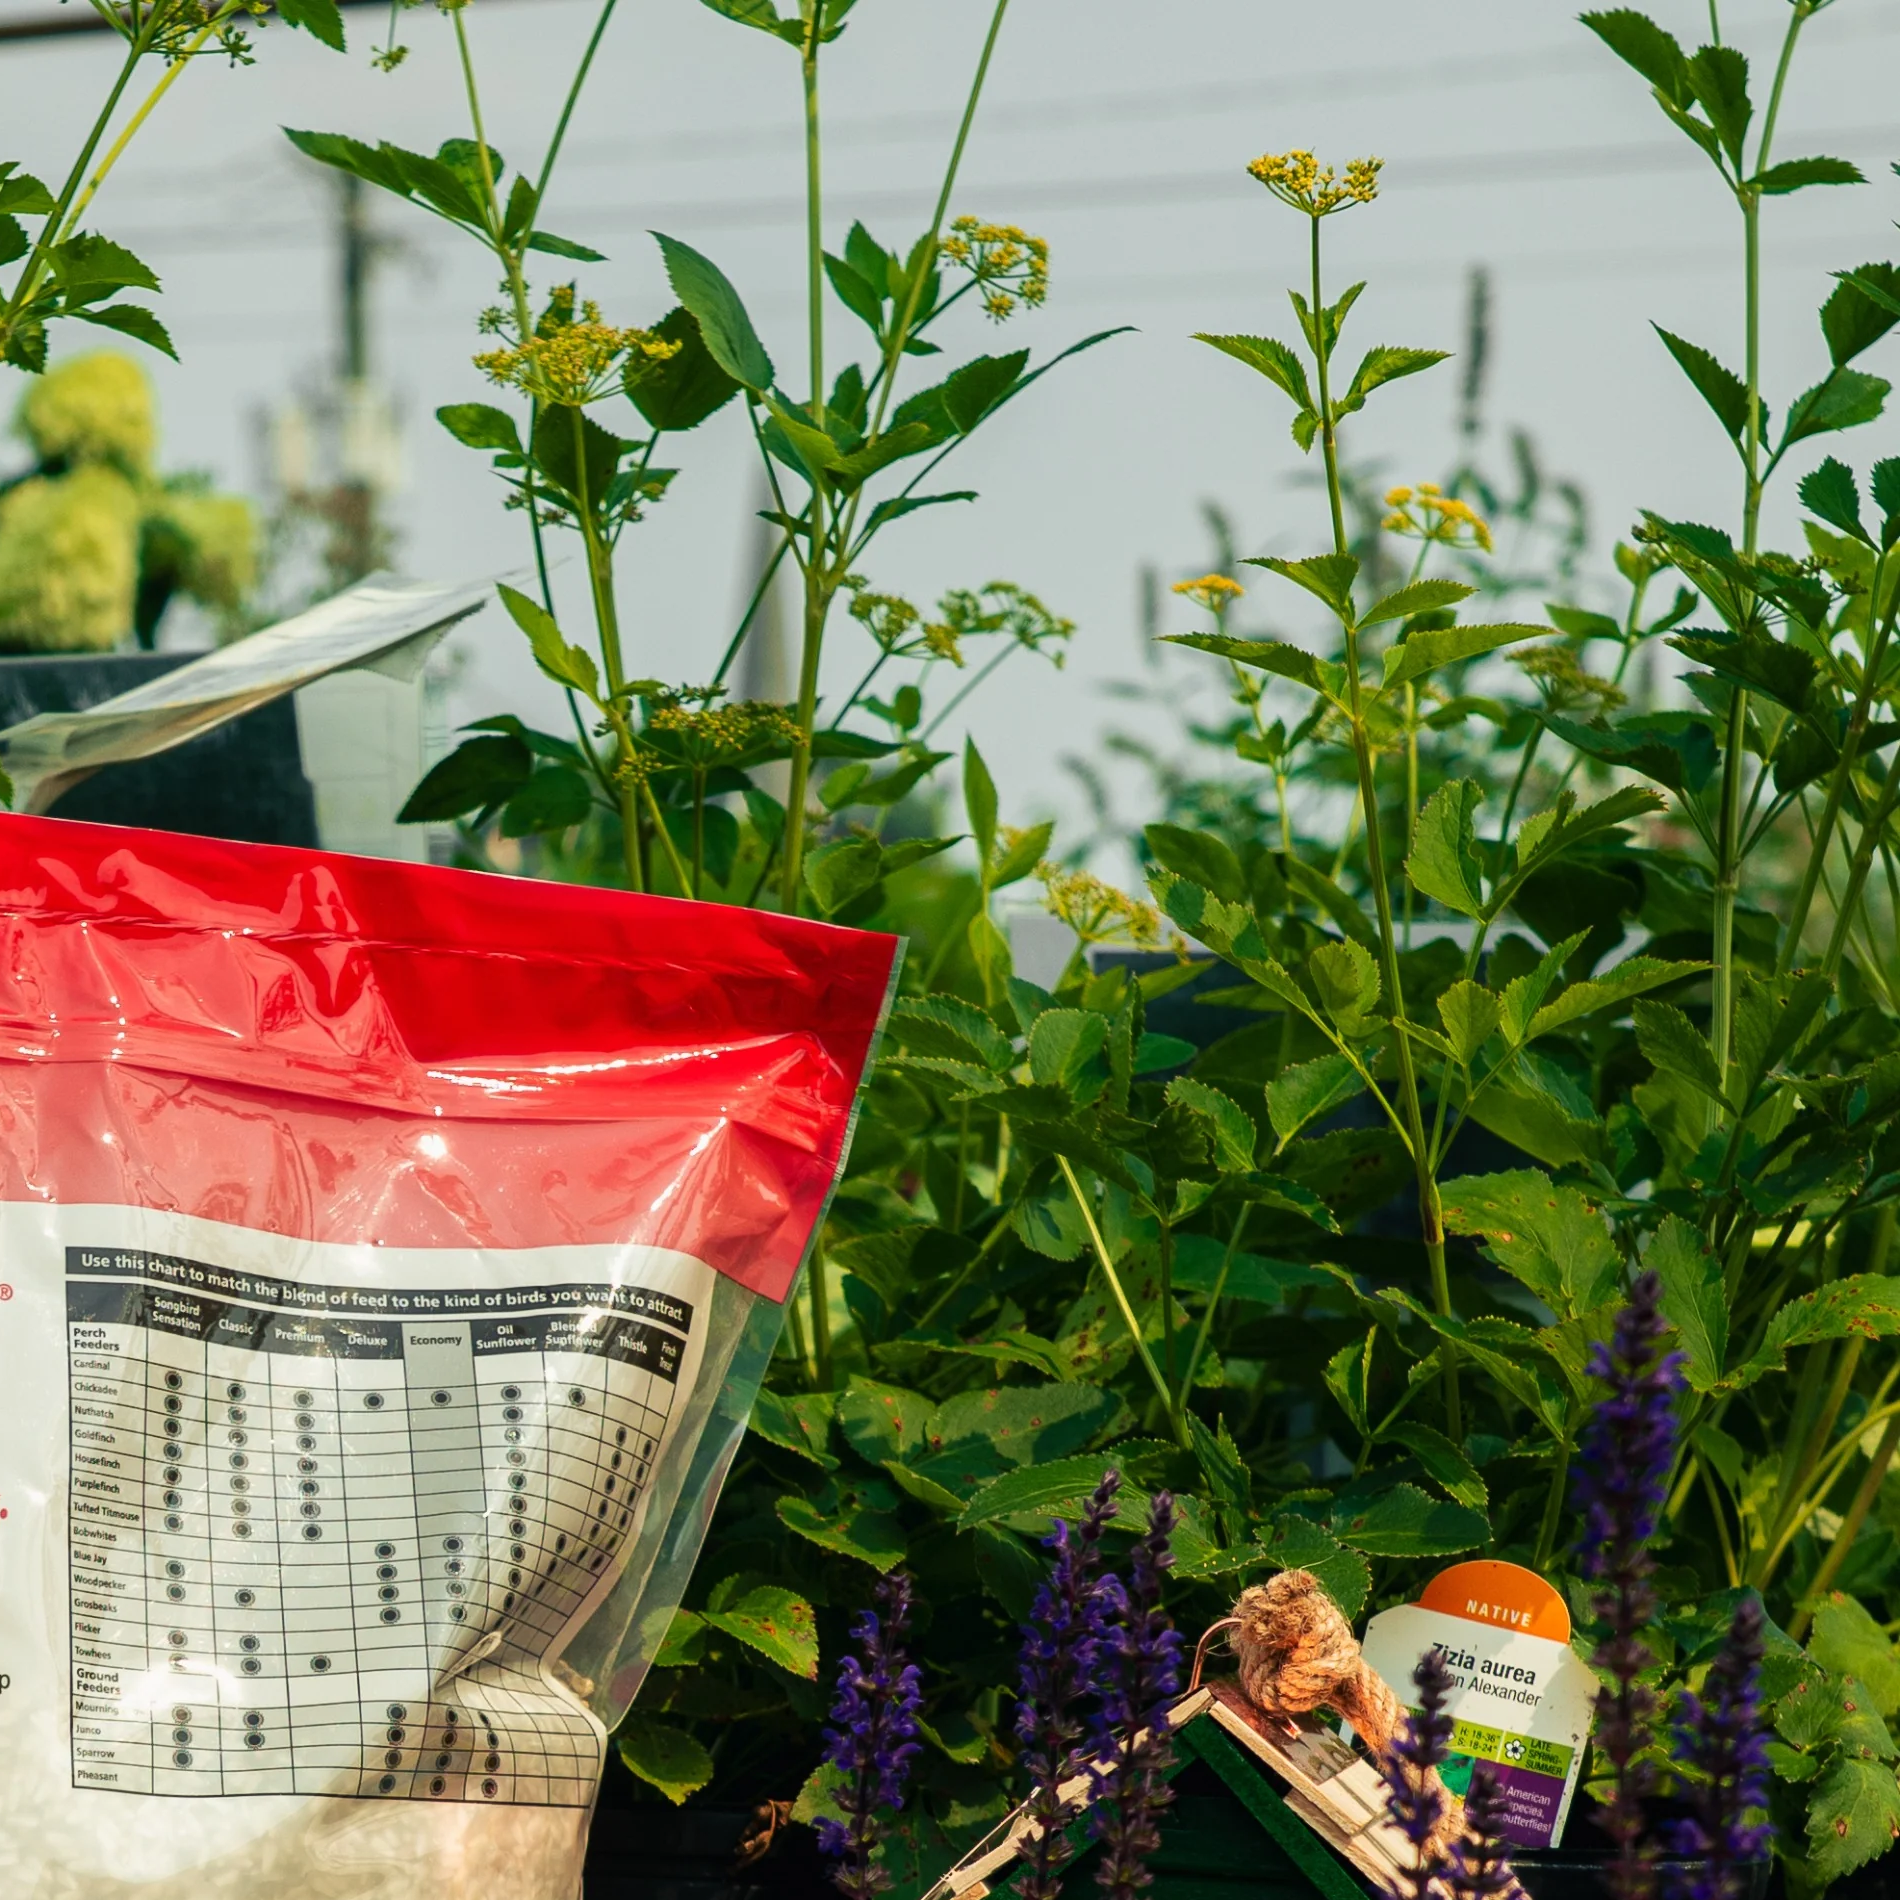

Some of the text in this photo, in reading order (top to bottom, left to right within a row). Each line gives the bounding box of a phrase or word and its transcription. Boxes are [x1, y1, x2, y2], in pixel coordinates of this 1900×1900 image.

[81, 1253, 684, 1322] Use this chart to match the blend of feed to the kind of birds you want to attract.
[154, 1296, 201, 1317] Songbird
[152, 1311, 201, 1332] Sensation
[74, 1327, 106, 1338] Perch
[218, 1318, 463, 1347] Classic Premium Deluxe Economy
[497, 1324, 514, 1335] Oil
[74, 1340, 120, 1351] Feeders
[476, 1335, 648, 1354] Sunflower Thistle
[74, 1359, 111, 1370] Cardinal
[74, 1382, 118, 1396] Chickadee
[1466, 1599, 1532, 1627] NATIVE
[1480, 1659, 1536, 1685] aurea
[1467, 1676, 1542, 1707] Alexander
[1460, 1726, 1469, 1736] H:
[1458, 1737, 1465, 1747] S:
[1530, 1738, 1552, 1752] LATE
[1528, 1749, 1563, 1764] SPRING-
[1525, 1761, 1563, 1776] SUMMER
[1506, 1785, 1551, 1806] American
